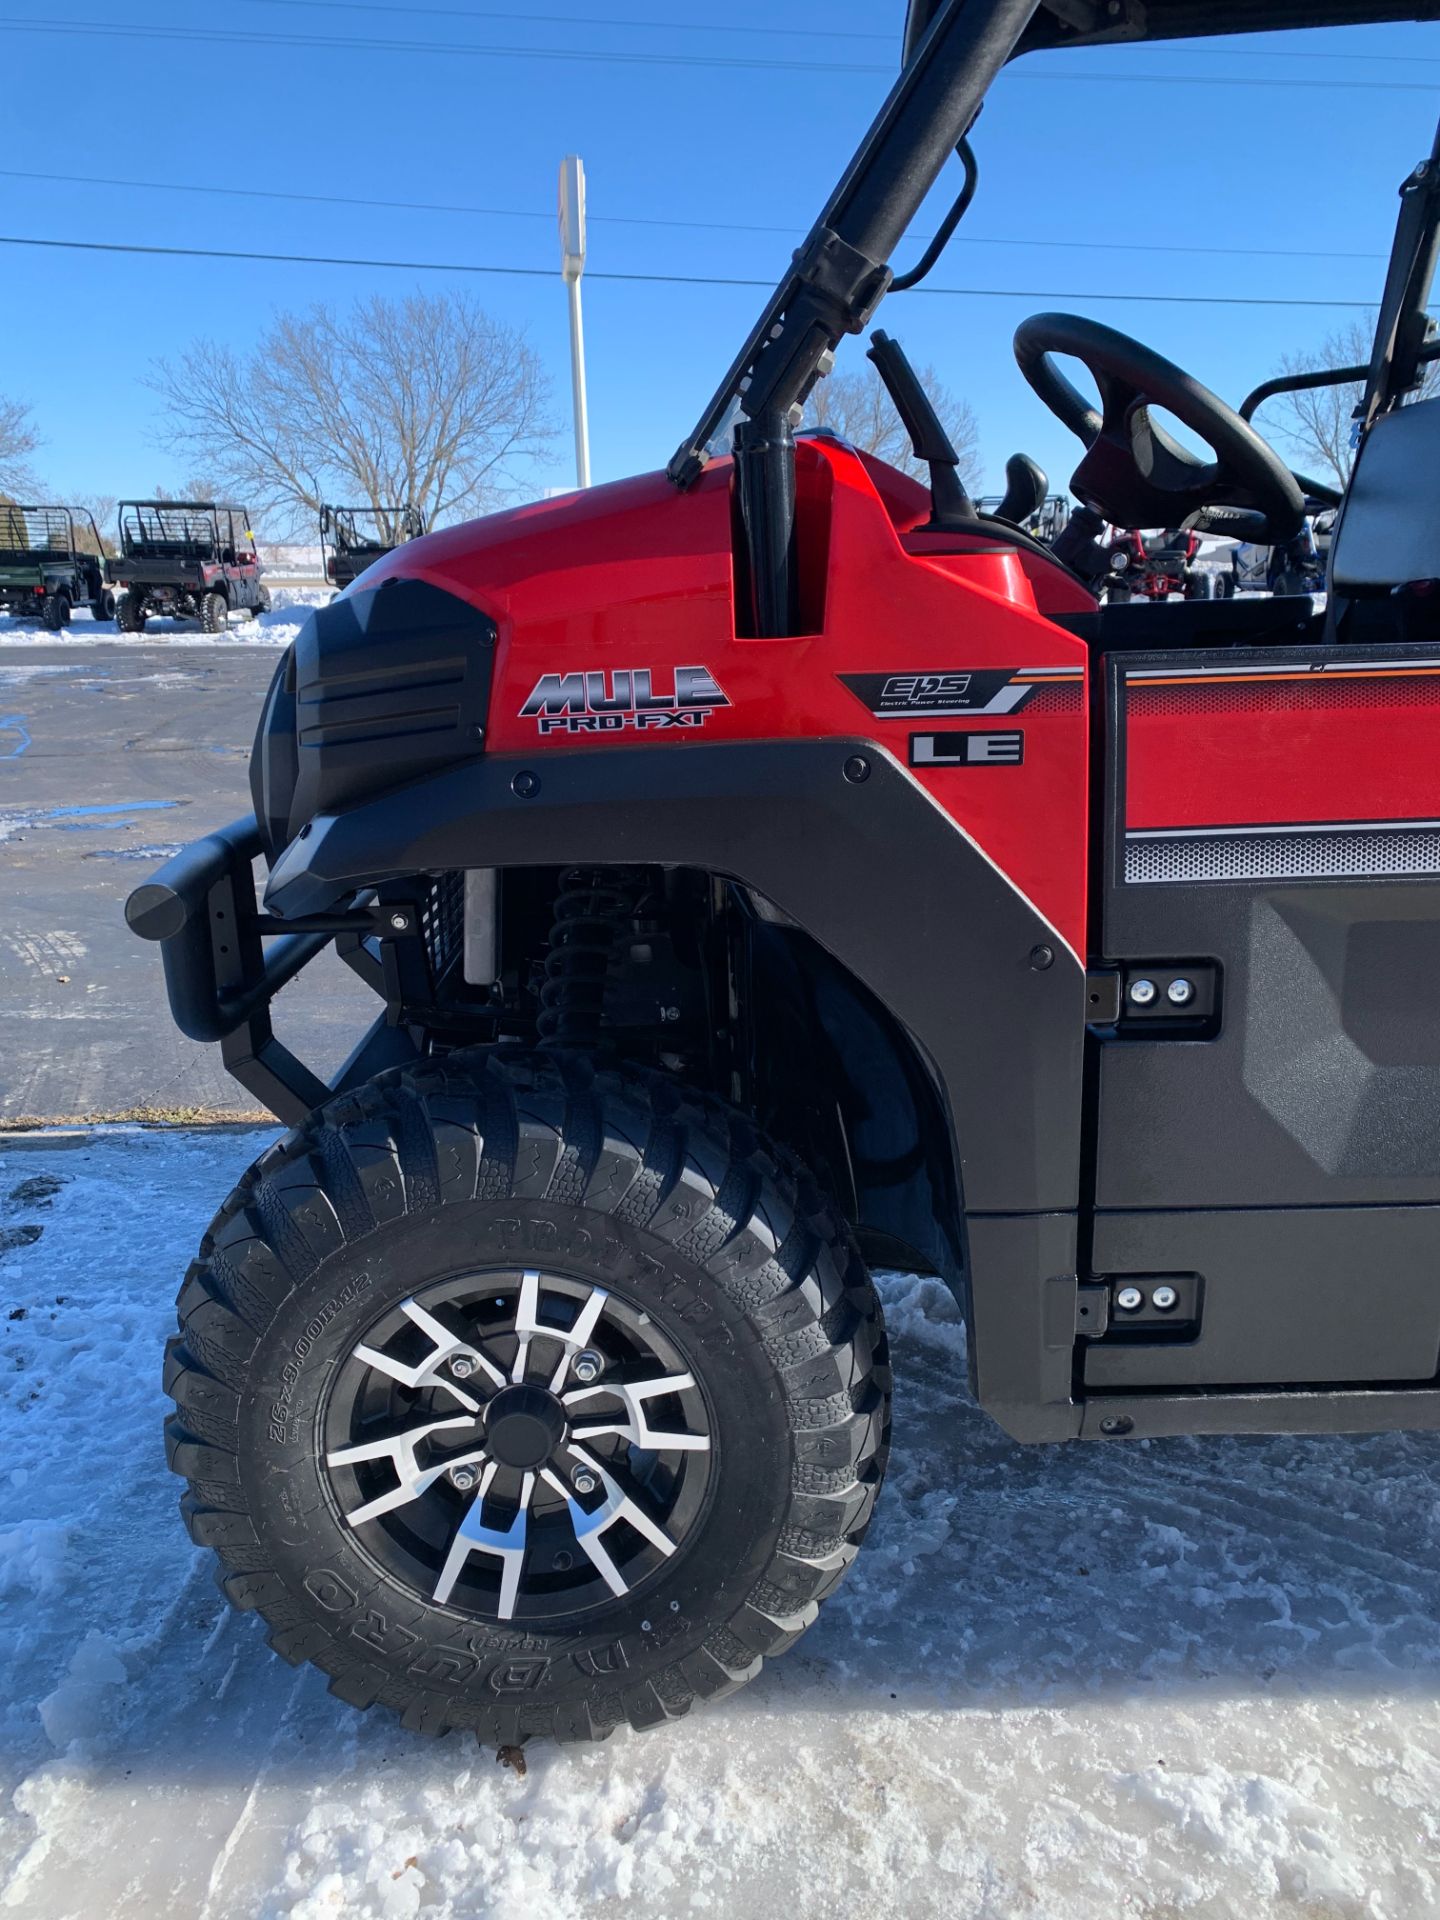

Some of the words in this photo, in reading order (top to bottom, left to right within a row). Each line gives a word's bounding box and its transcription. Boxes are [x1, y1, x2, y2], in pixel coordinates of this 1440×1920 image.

[518, 665, 733, 717] MULE
[881, 674, 972, 701] EPS
[538, 708, 712, 735] PRO-FXT
[913, 734, 1020, 763] LE
